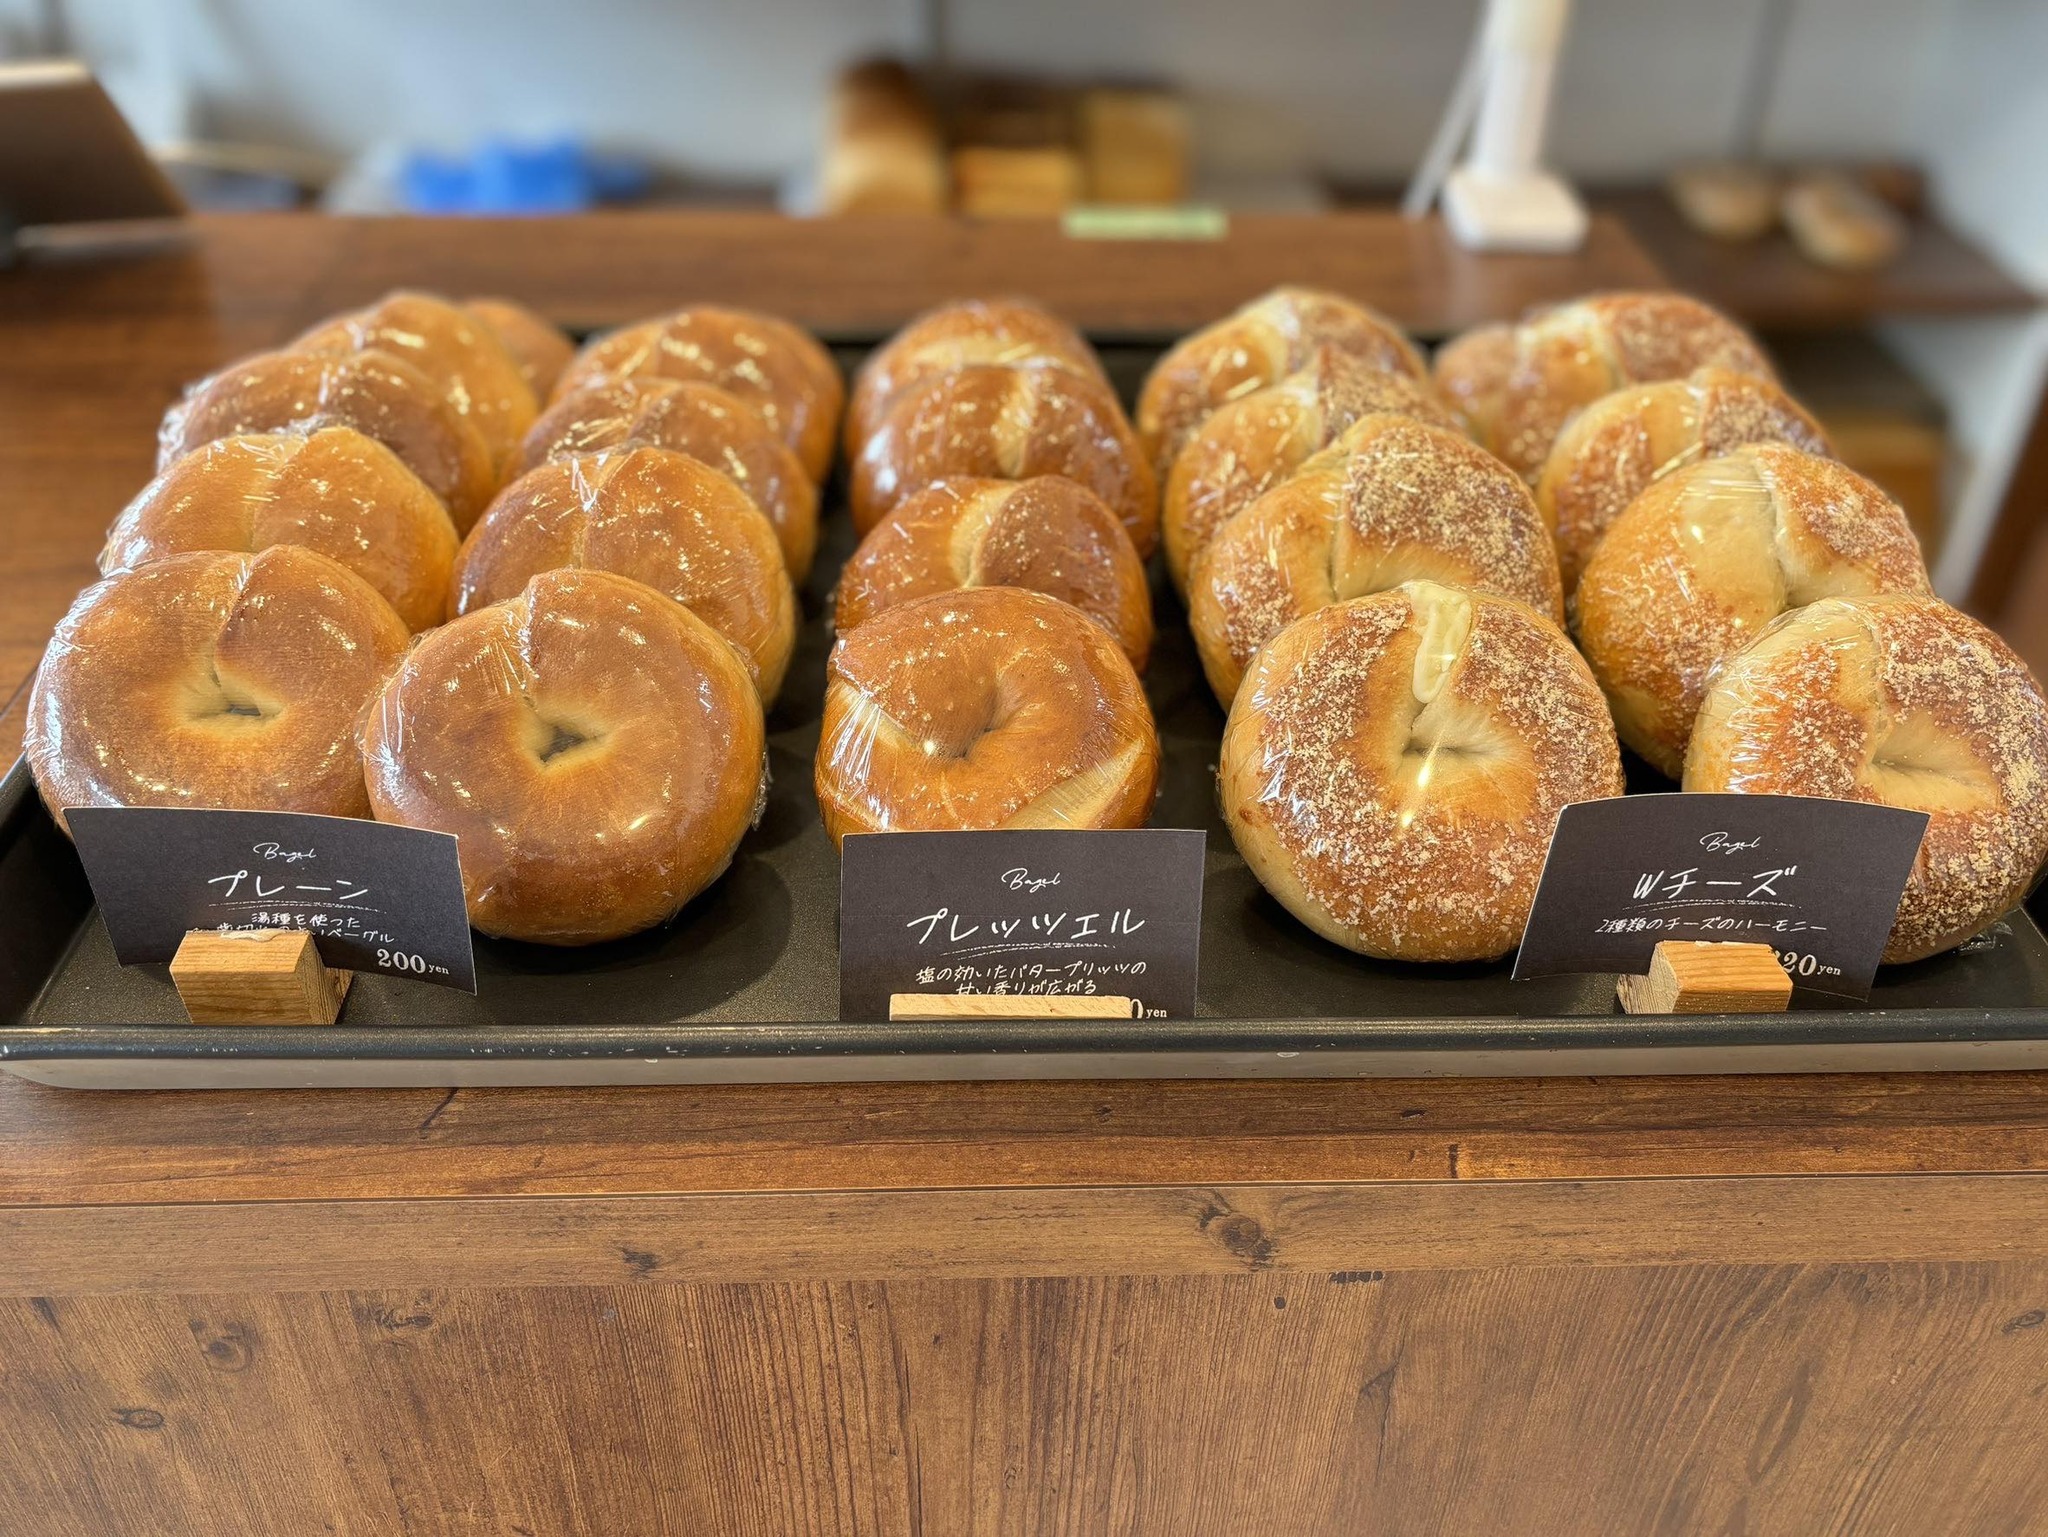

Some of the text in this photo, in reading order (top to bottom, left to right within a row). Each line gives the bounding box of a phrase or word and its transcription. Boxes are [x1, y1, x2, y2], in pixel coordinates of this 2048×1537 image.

[252, 842, 317, 863] Bagel
[1699, 831, 1761, 855] Bagel
[207, 868, 370, 900] プレーン
[1000, 867, 1061, 893] Bagel
[1632, 865, 1798, 900] Wチーズ
[251, 912, 361, 929] 湯種を使った
[1594, 915, 1828, 934] 2種類のチーズのハーモニー
[955, 979, 1098, 997] 甘い香りが広がる
